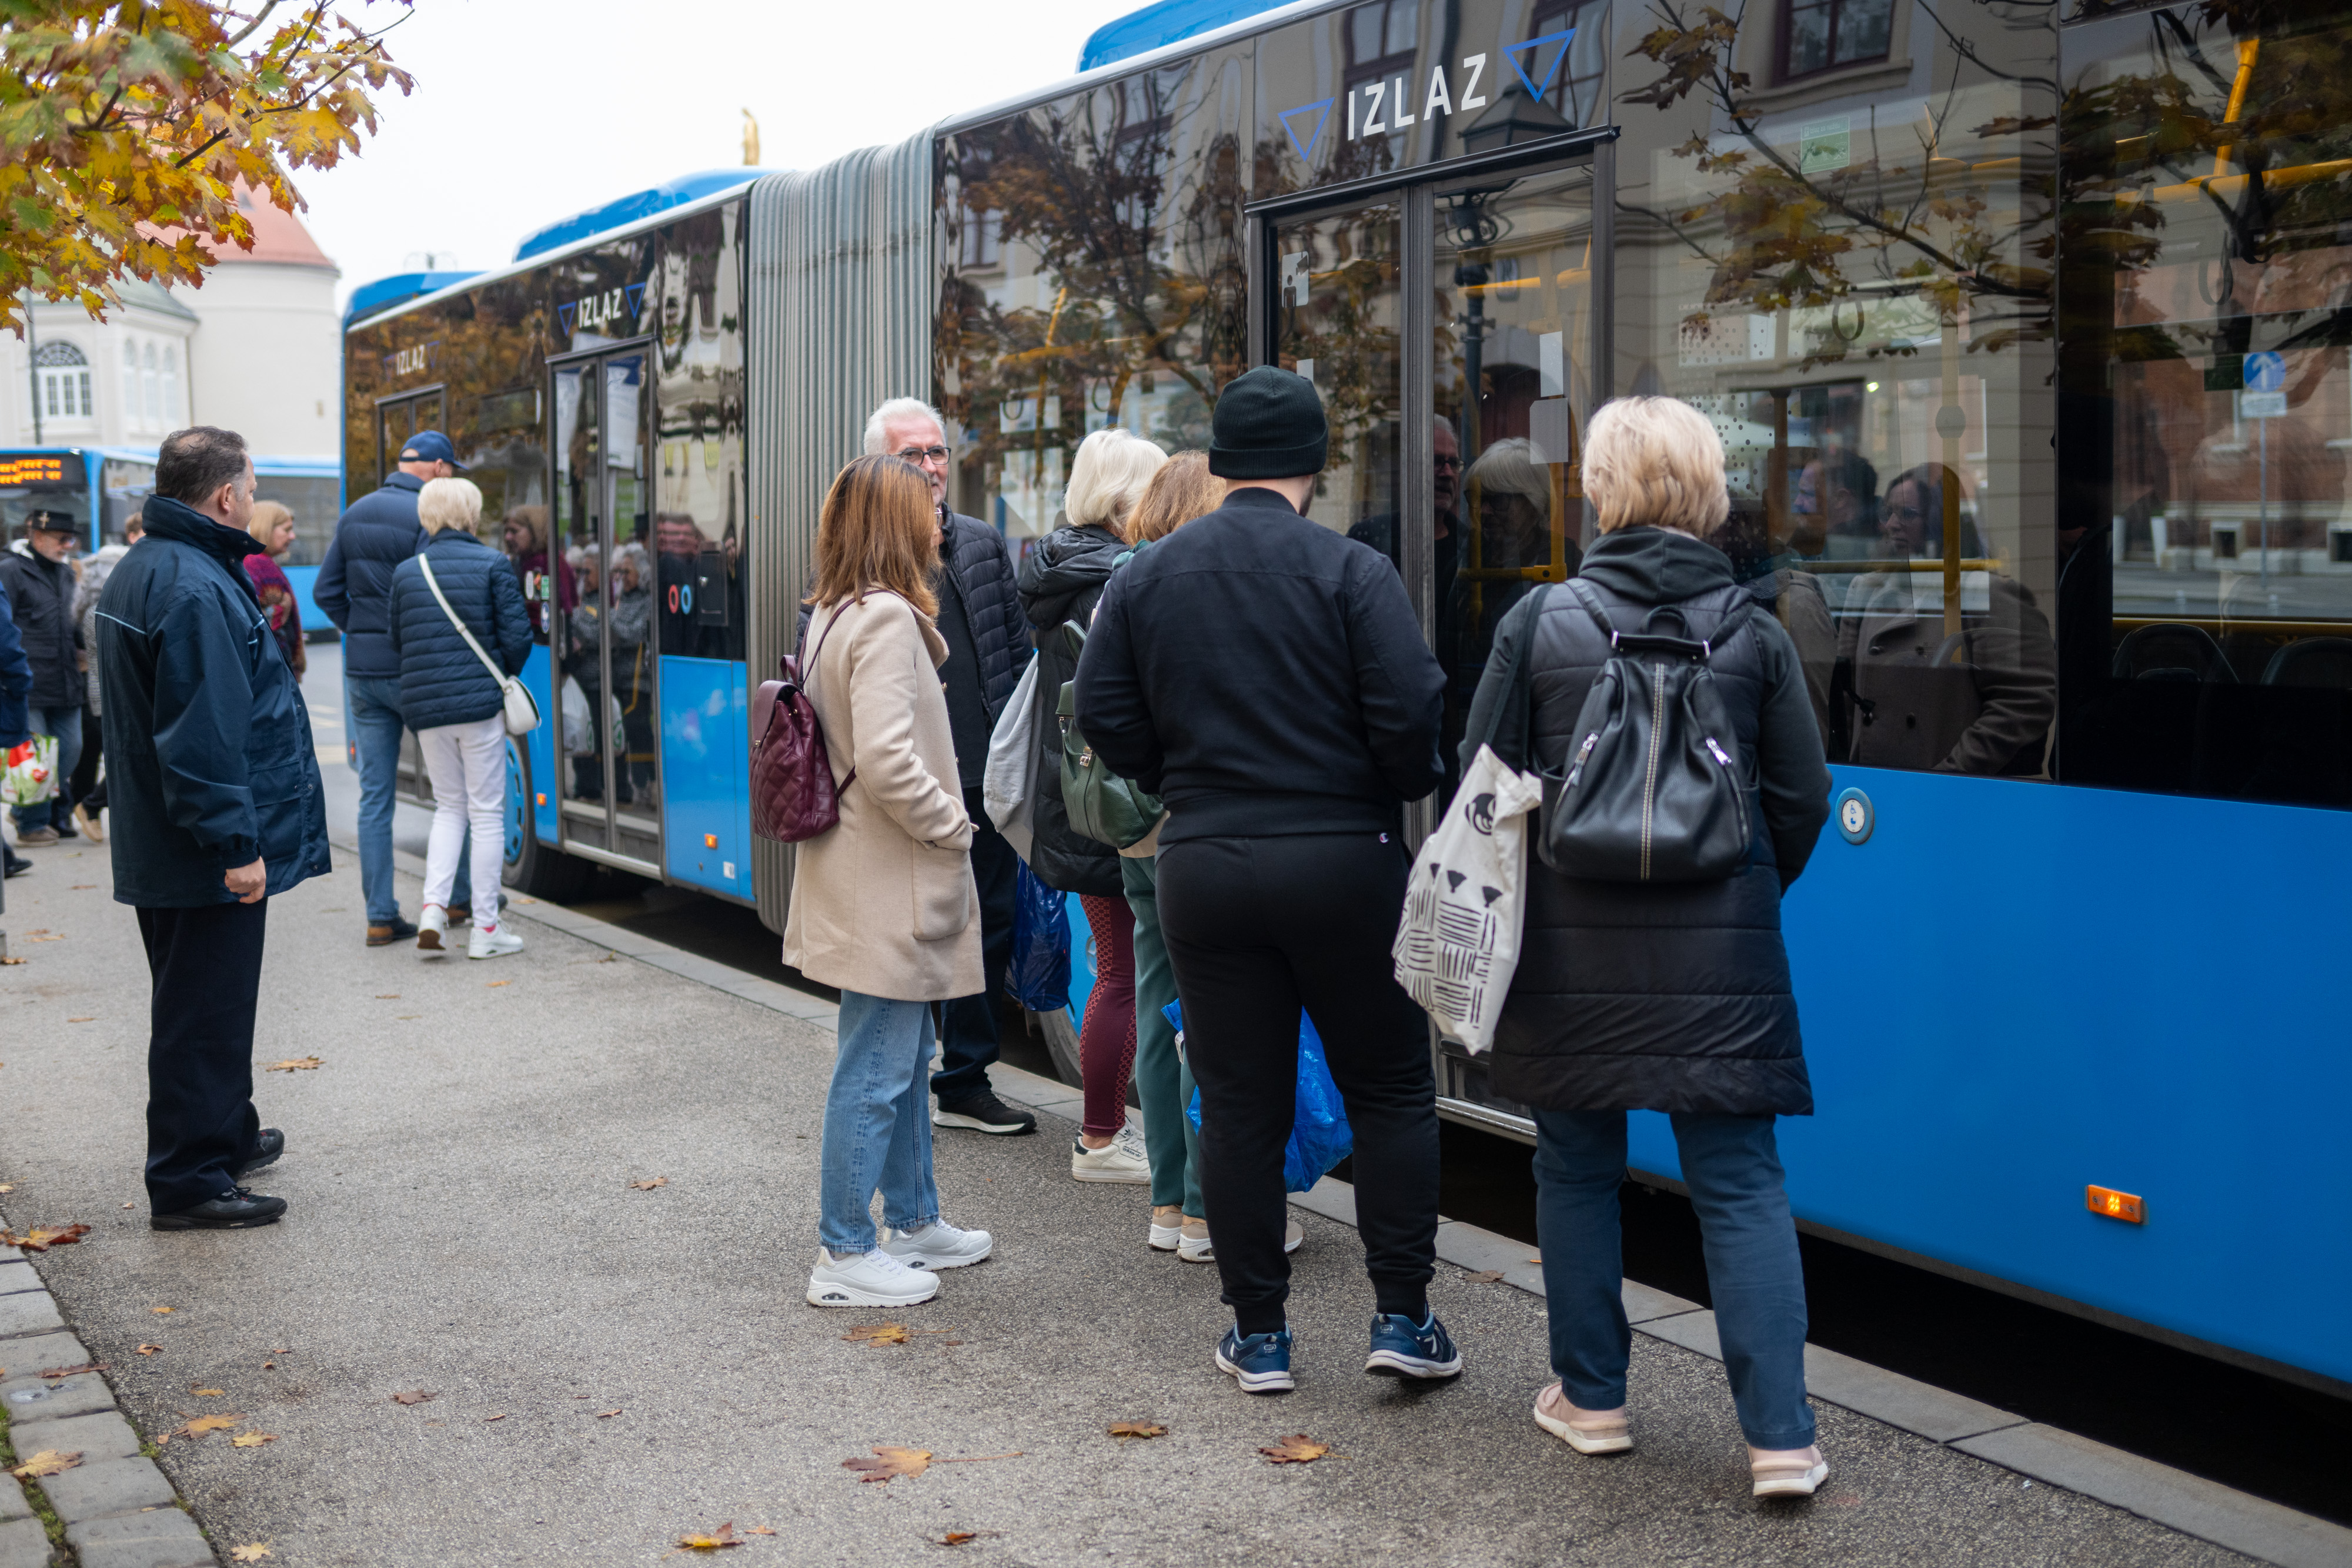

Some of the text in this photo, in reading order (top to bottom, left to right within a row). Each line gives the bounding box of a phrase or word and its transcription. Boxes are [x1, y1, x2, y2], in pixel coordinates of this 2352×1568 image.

[1348, 52, 1486, 141] IZLAZ
[579, 287, 622, 329] IZLAZ
[396, 344, 425, 376] IZLAZ
